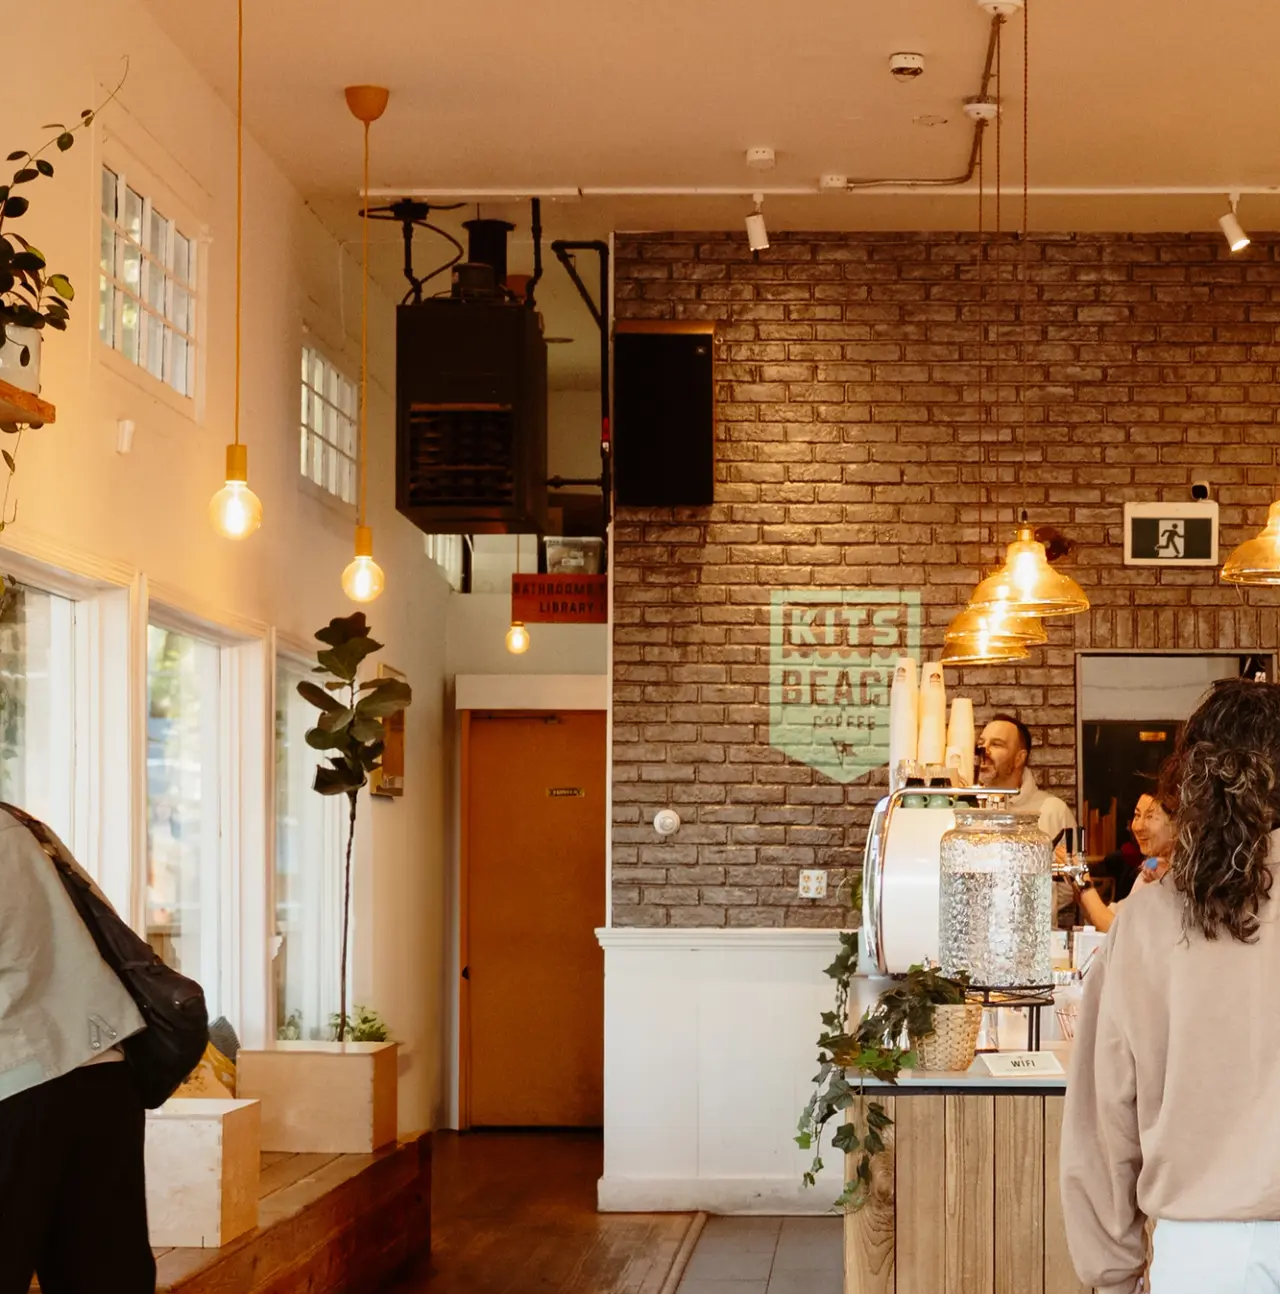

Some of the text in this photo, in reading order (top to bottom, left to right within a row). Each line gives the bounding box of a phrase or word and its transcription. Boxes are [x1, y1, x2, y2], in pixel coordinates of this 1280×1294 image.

[513, 582, 594, 595] BATHROOMS
[540, 602, 594, 613] LIBRARY
[791, 609, 900, 645] KITS
[814, 716, 876, 730] COFFEE
[1011, 1060, 1035, 1068] WIFI
